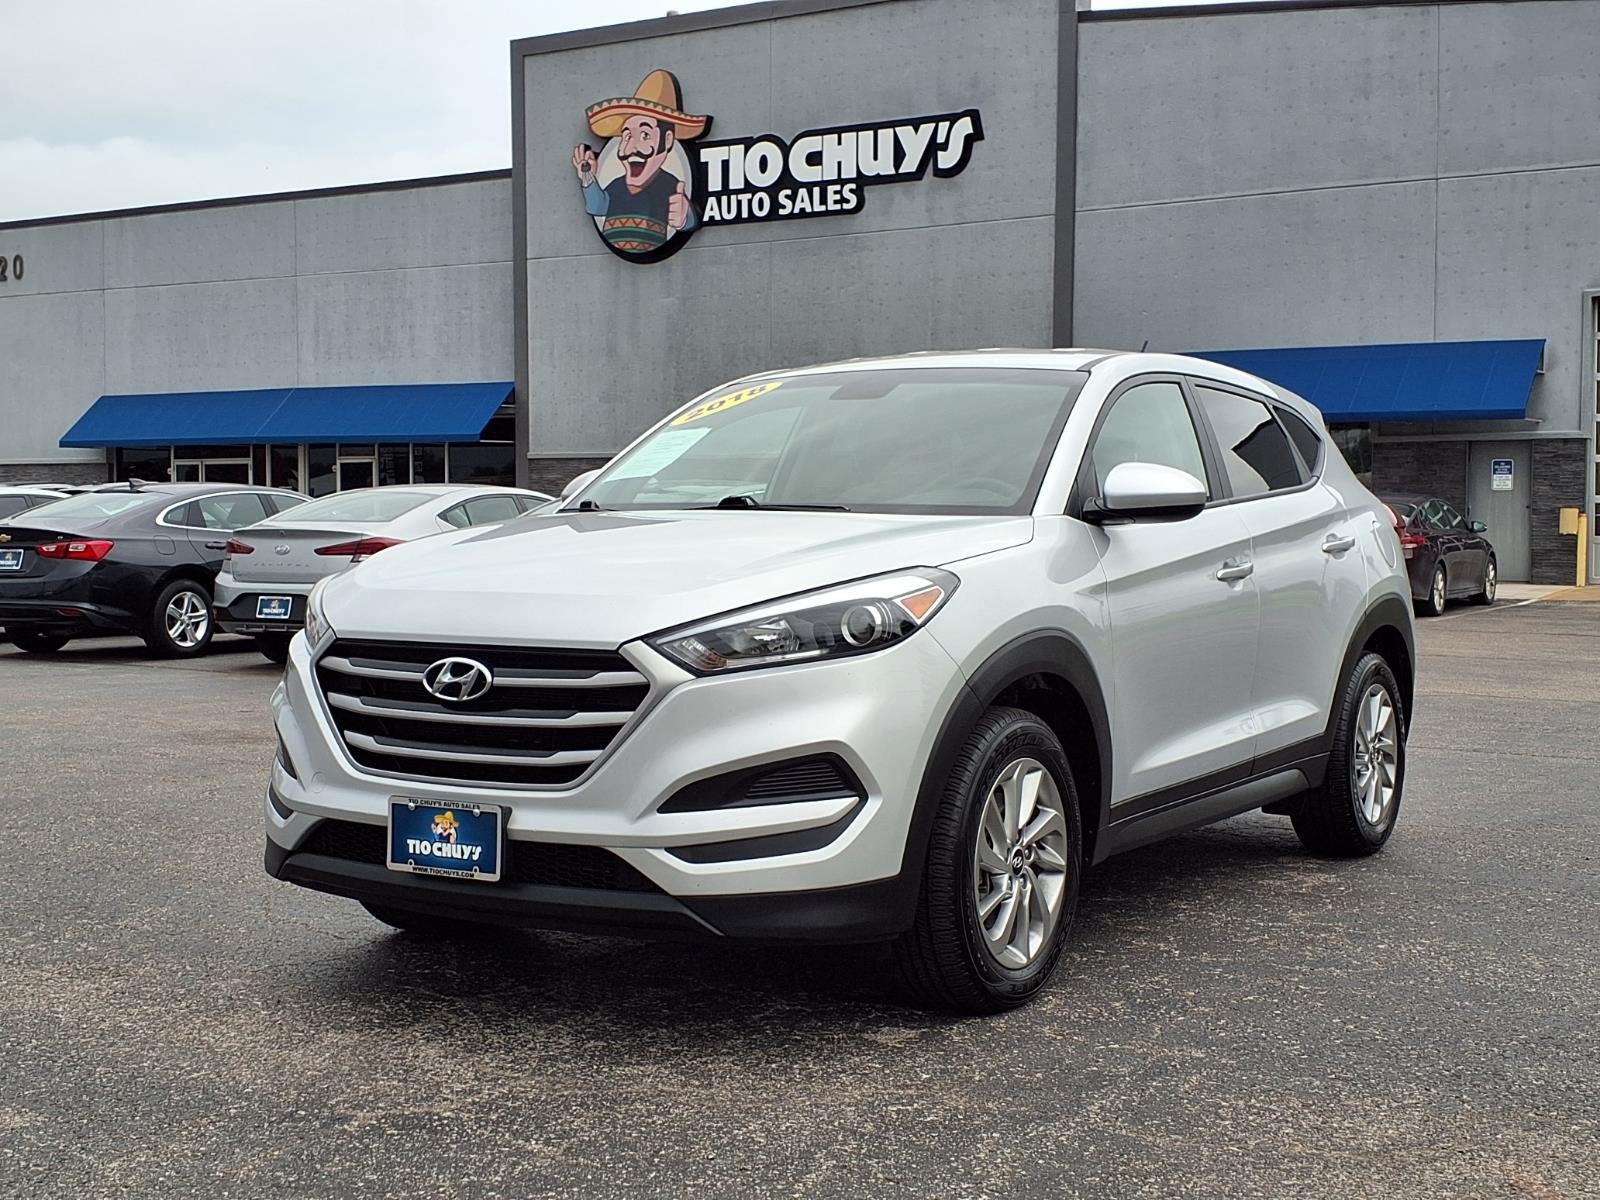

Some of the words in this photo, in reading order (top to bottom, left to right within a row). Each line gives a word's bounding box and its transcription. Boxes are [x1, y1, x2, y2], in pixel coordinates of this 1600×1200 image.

[700, 143, 784, 193] TIO
[788, 115, 973, 183] CHUY'S
[702, 193, 770, 222] AUTO
[778, 183, 857, 216] SALES
[443, 801, 460, 809] AUTO
[407, 839, 432, 856] TIO
[432, 841, 482, 861] CHUY'S
